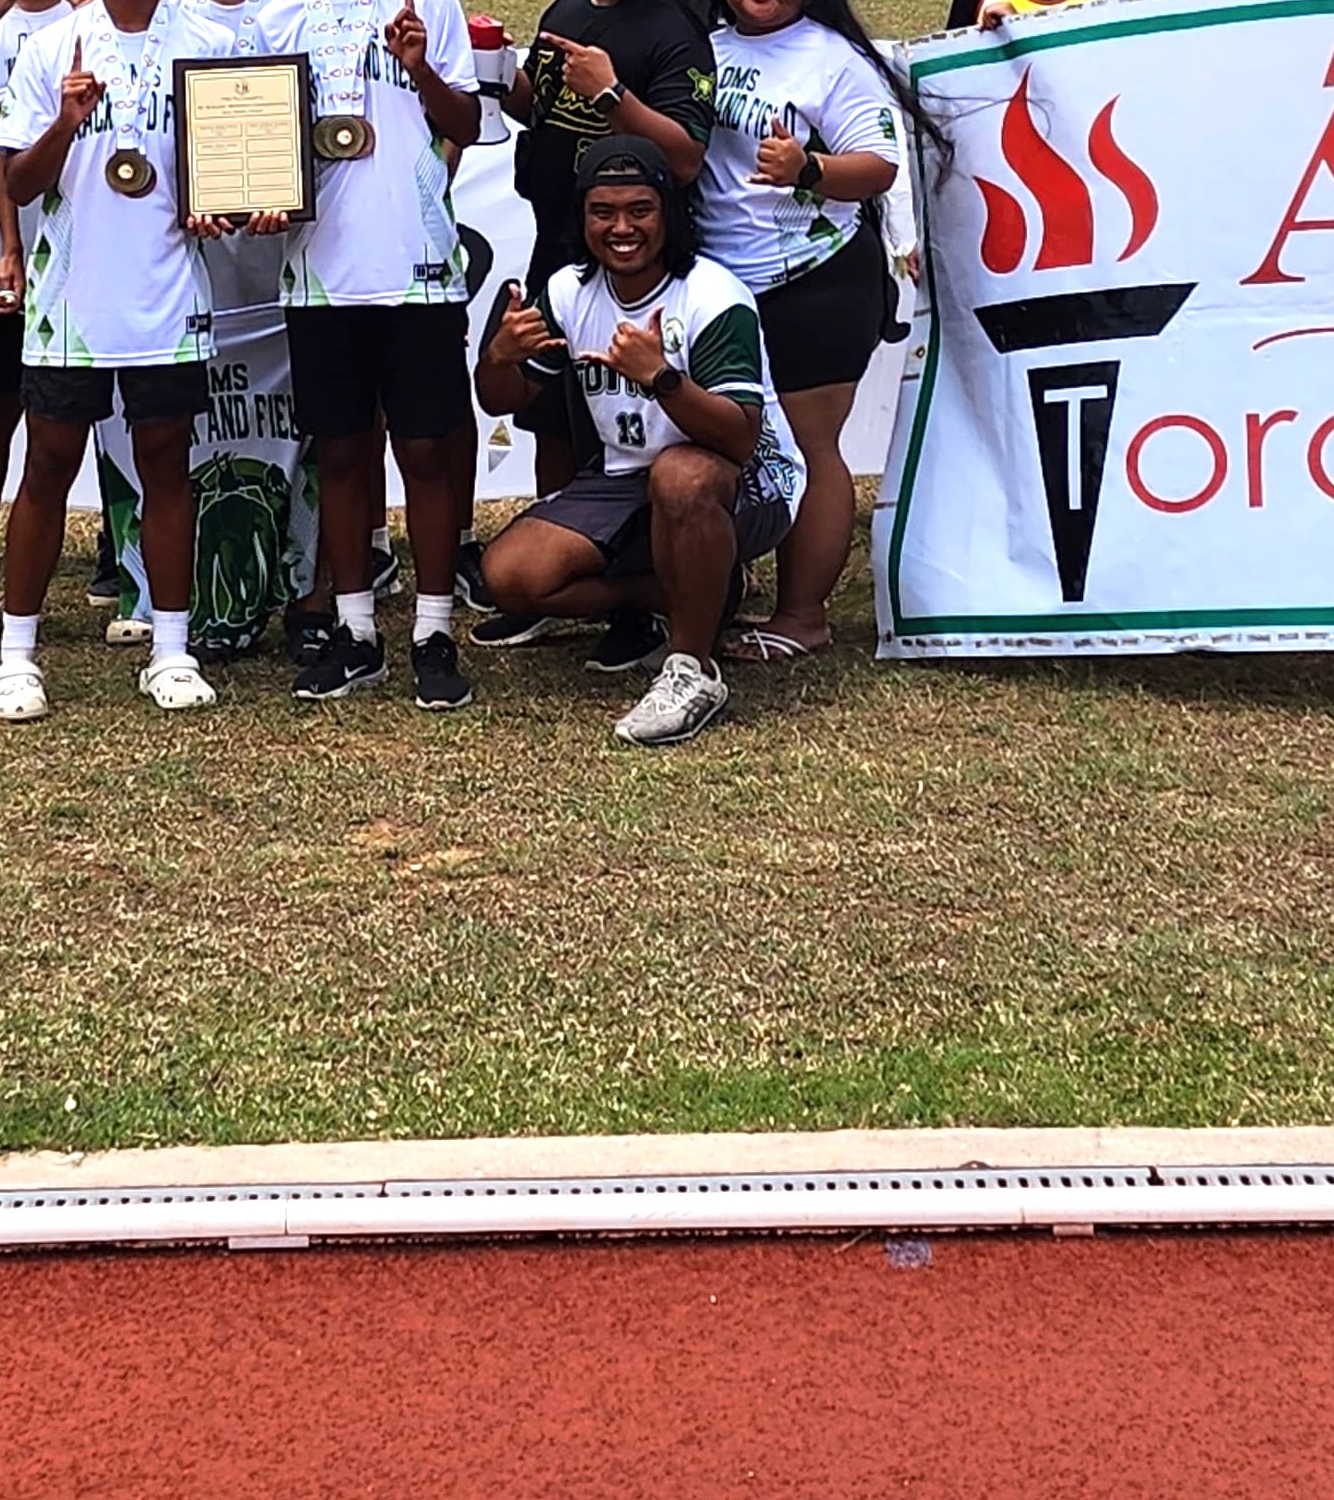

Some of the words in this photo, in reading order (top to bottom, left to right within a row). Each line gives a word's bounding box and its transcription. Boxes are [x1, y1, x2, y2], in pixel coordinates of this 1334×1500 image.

[719, 66, 761, 92] DMS
[745, 97, 797, 141] FIED
[209, 362, 249, 394] MS
[207, 393, 250, 443] AND
[253, 392, 301, 441] FIEL
